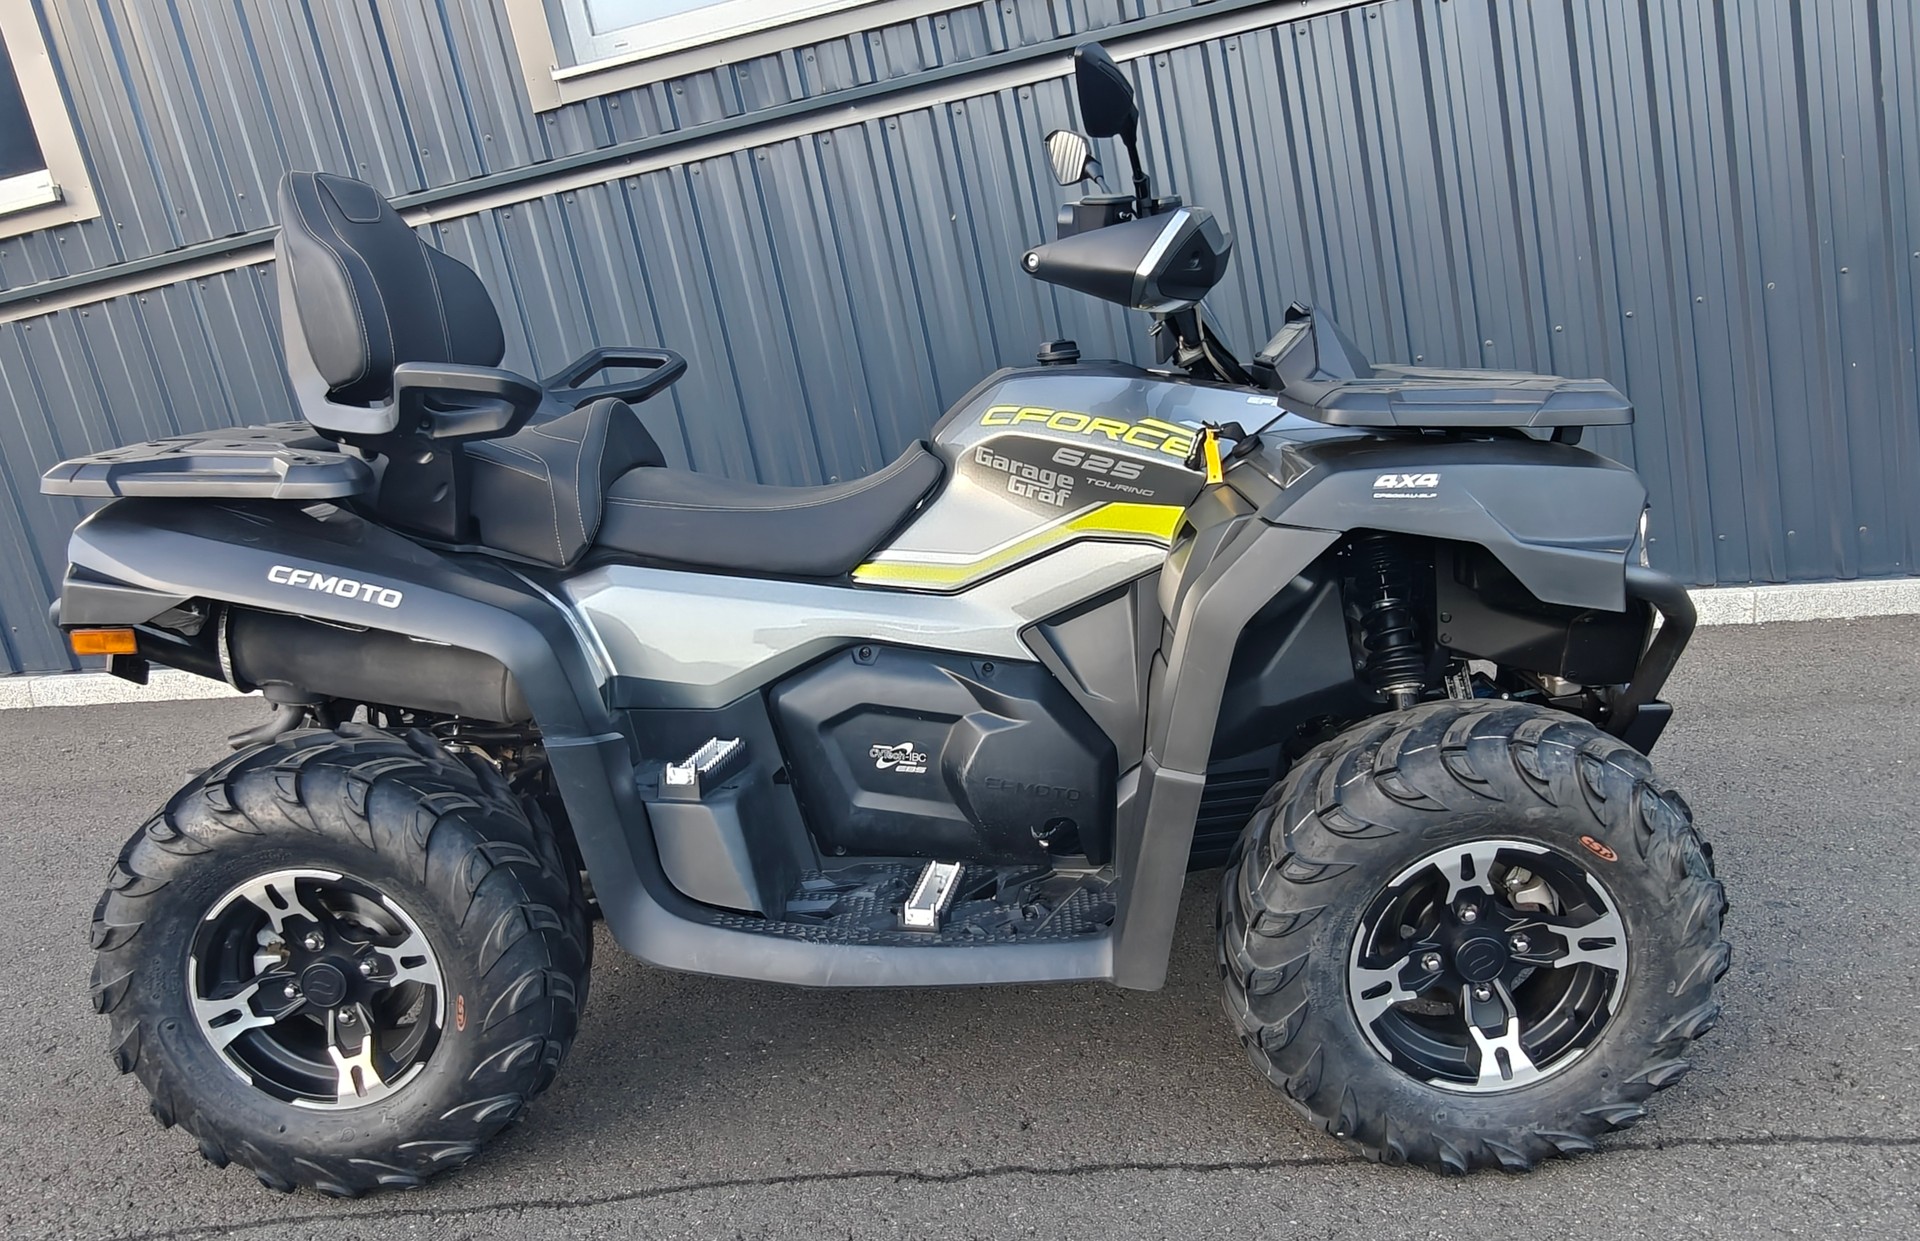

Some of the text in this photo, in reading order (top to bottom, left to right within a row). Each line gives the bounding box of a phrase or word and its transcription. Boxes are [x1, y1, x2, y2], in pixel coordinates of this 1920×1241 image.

[979, 405, 1200, 459] CFORCE
[974, 445, 1075, 490] Garage
[1051, 447, 1146, 480] 625
[1007, 474, 1072, 507] Graf
[1085, 477, 1155, 497] TOURING
[267, 565, 403, 609] CFMOTO
[984, 776, 1081, 801] CFMOTO
